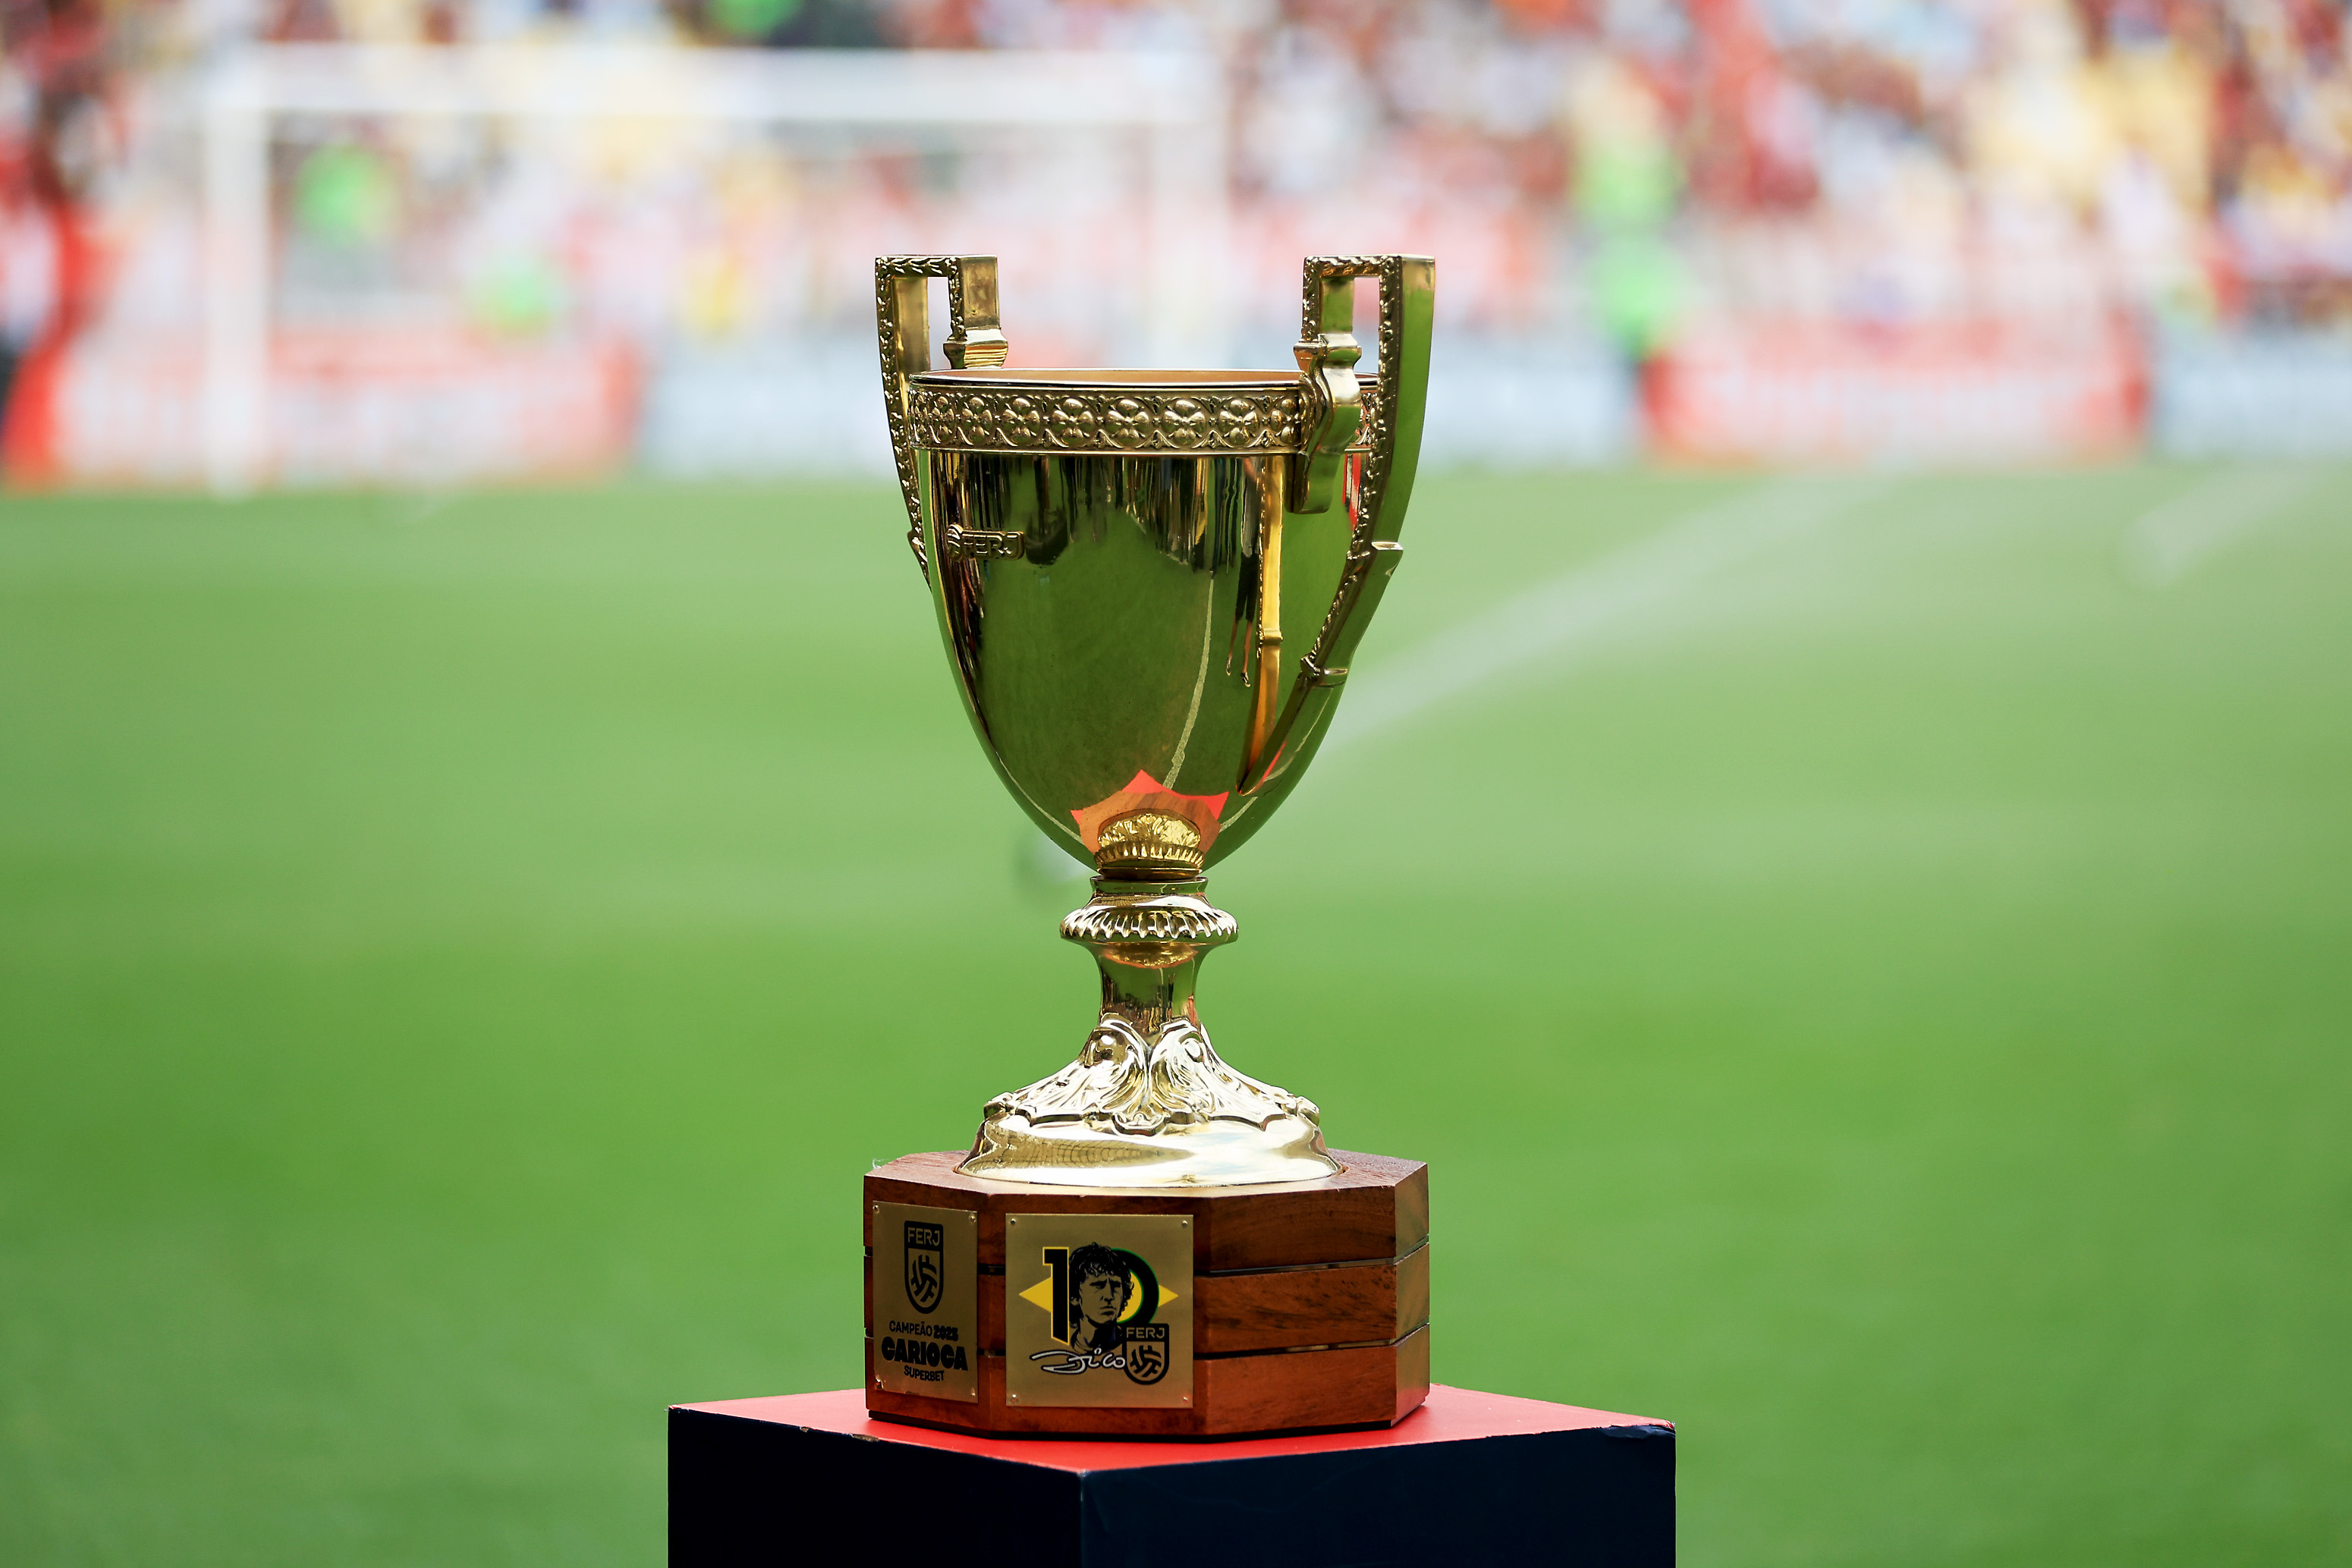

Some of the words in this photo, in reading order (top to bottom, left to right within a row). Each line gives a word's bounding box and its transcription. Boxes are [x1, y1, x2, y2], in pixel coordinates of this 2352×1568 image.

[962, 533, 1019, 557] FERJ
[907, 1227, 940, 1246] FERJ
[889, 1320, 933, 1337] CAMPEÃO
[933, 1324, 959, 1342] 2025
[1126, 1327, 1165, 1339] FERJ
[881, 1336, 968, 1372] CARIOCA
[904, 1365, 945, 1381] SUPERBET
